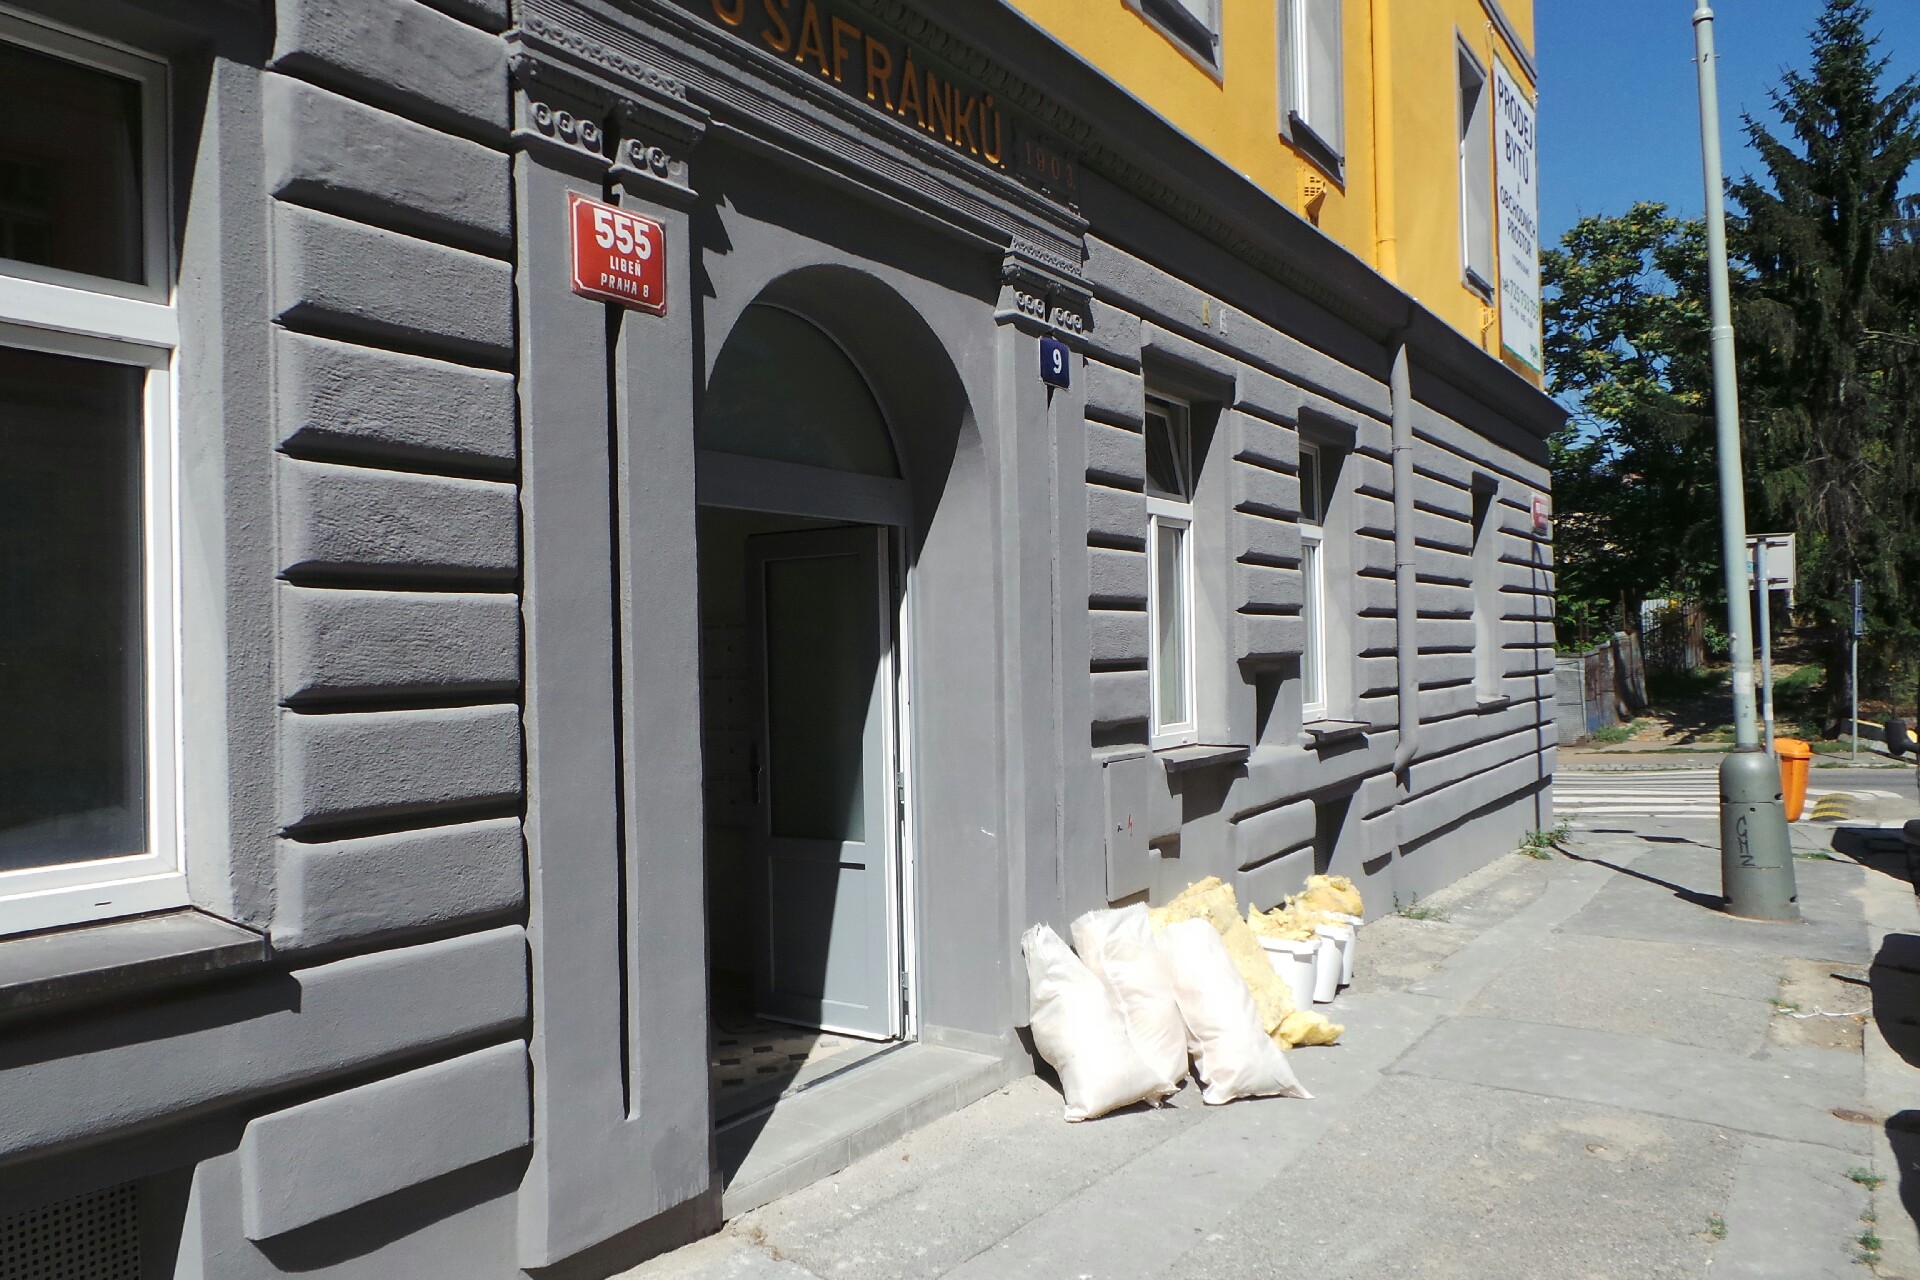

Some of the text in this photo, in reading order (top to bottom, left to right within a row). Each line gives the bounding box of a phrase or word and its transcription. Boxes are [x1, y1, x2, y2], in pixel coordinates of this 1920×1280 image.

[1498, 75, 1533, 150] PRODEJ
[1505, 129, 1529, 185] BYTŮ
[593, 207, 651, 260] 555
[1500, 185, 1536, 240] OBCHODNÍCH
[1508, 217, 1532, 258] PROSTOR
[601, 273, 649, 298] PRAHA 8
[610, 255, 641, 277] LIBEŇ
[1053, 348, 1062, 374] 9
